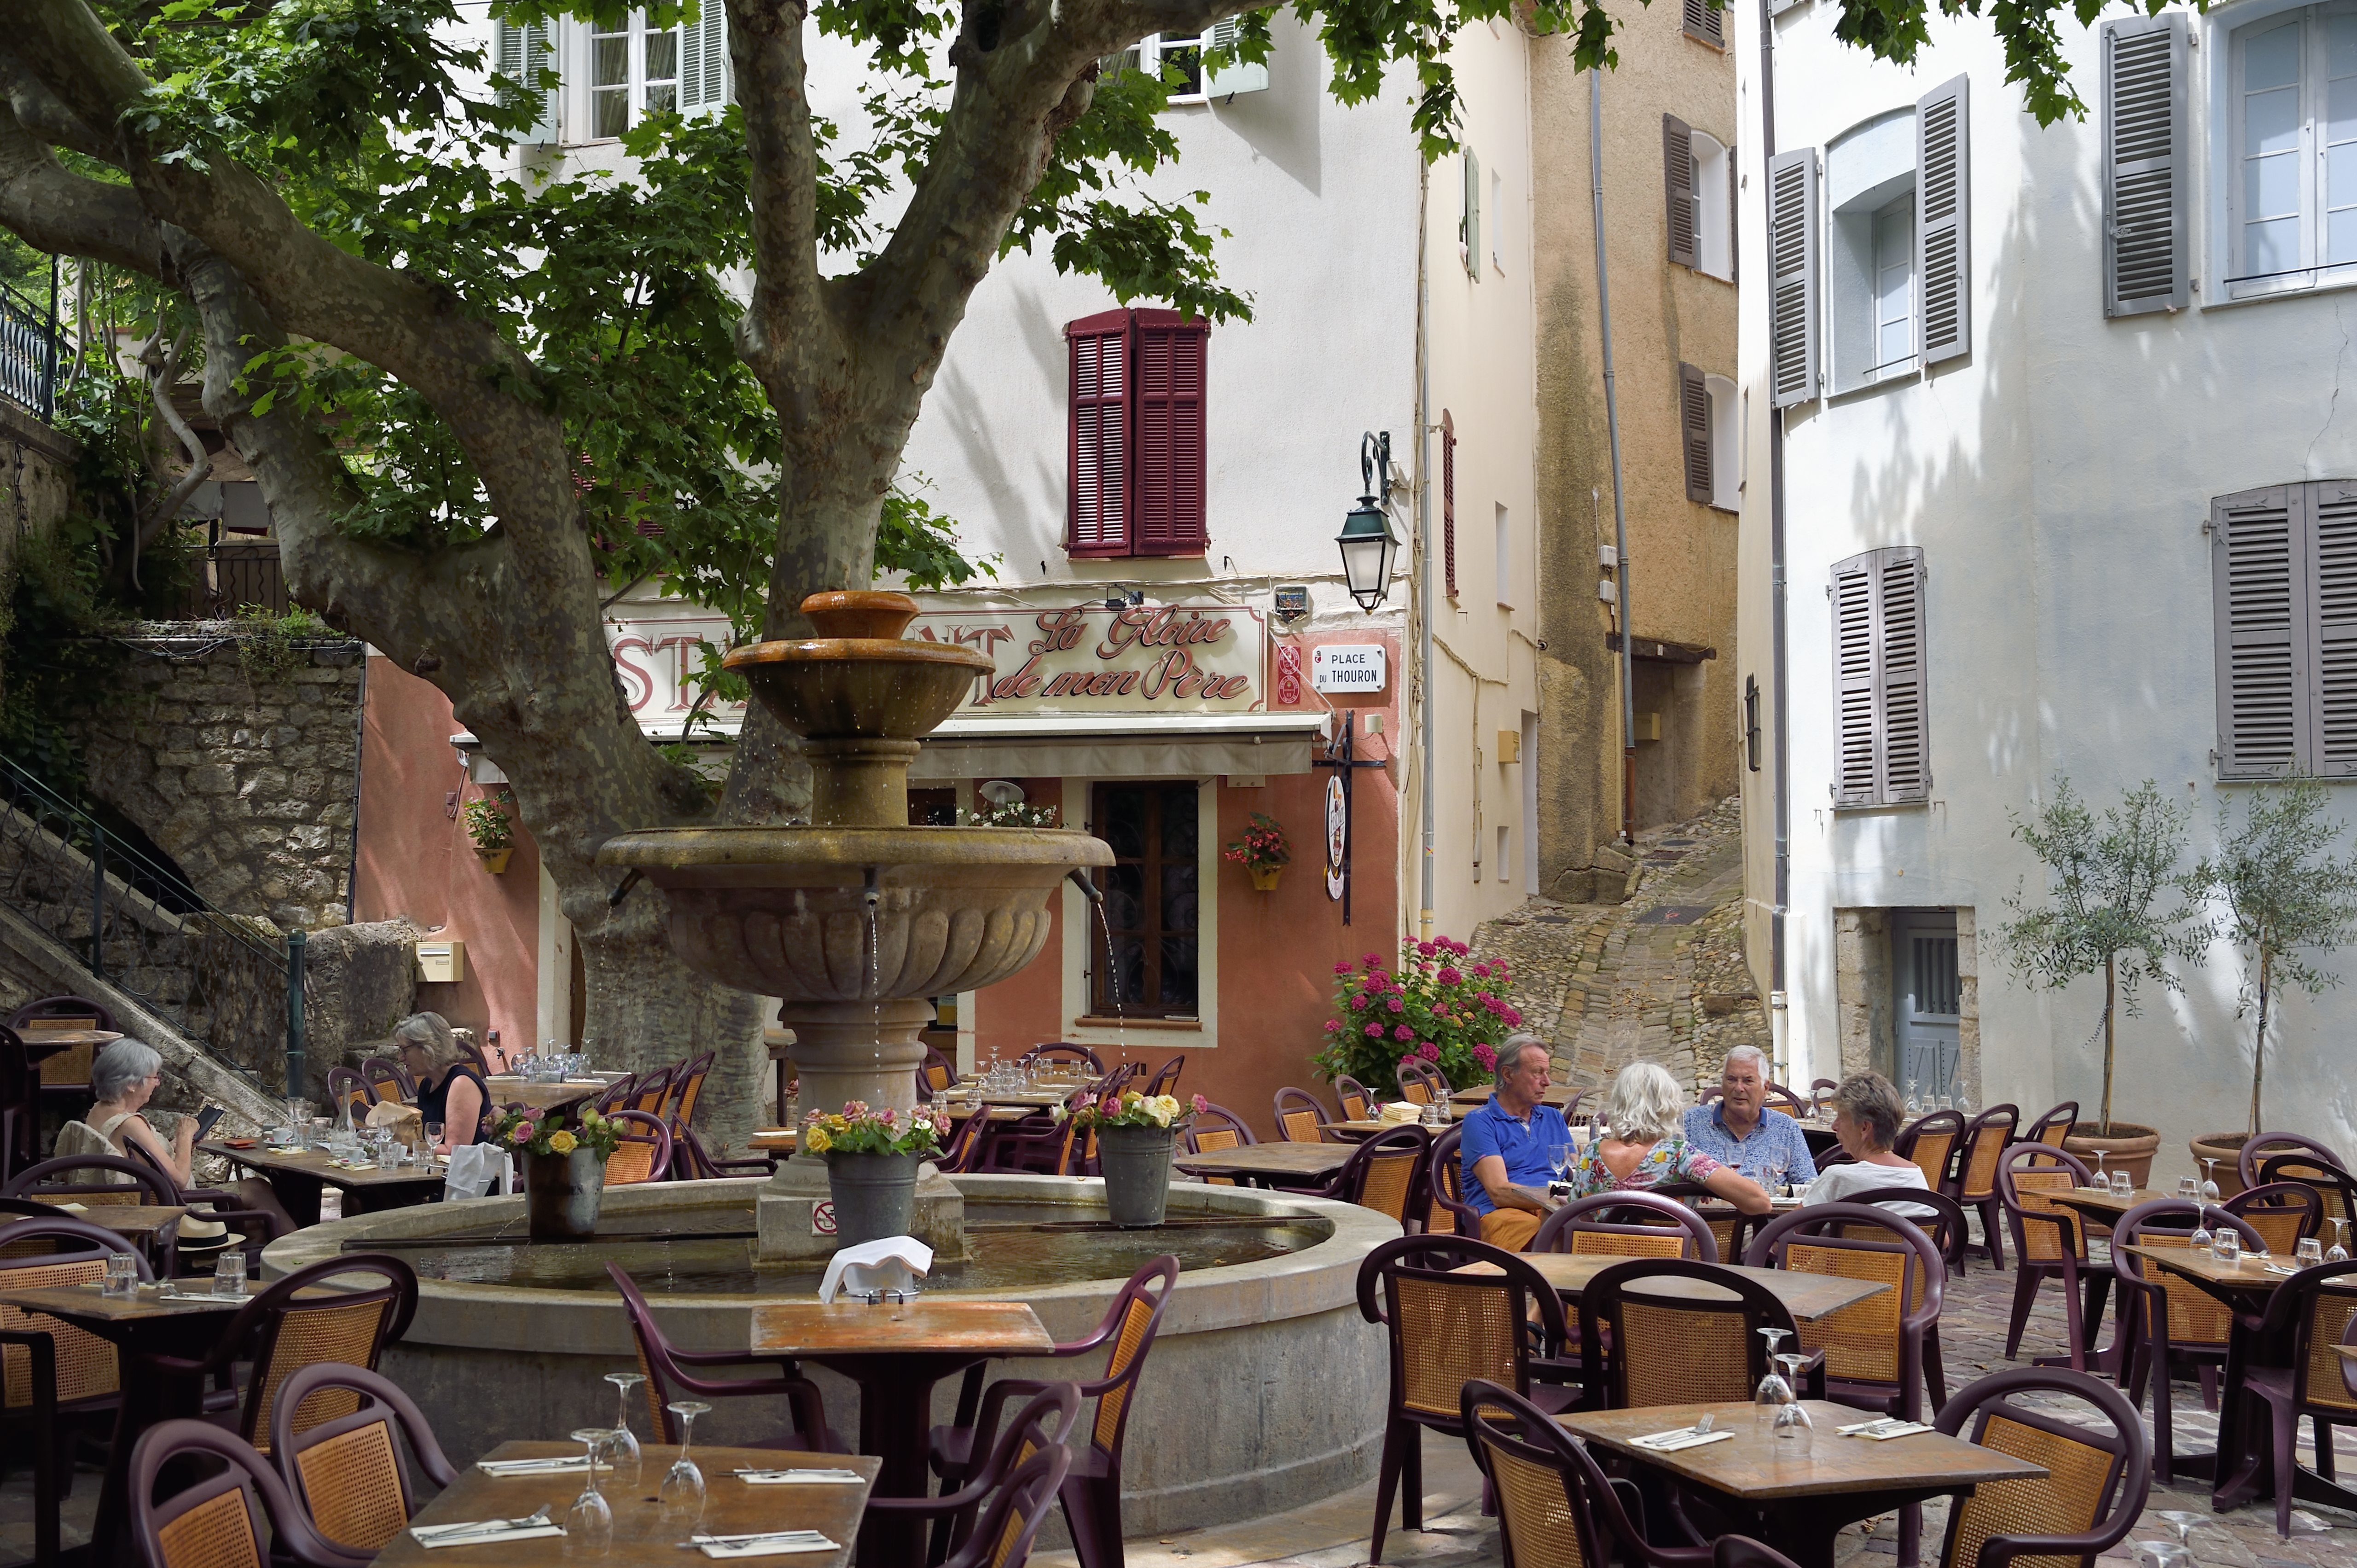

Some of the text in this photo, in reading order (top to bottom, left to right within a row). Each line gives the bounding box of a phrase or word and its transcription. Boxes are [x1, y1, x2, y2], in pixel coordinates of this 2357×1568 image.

[1028, 604, 1231, 659] La Gloire
[993, 649, 1250, 700] de mon Père
[1332, 654, 1365, 664] PLACE
[1332, 670, 1376, 682] THOURON
